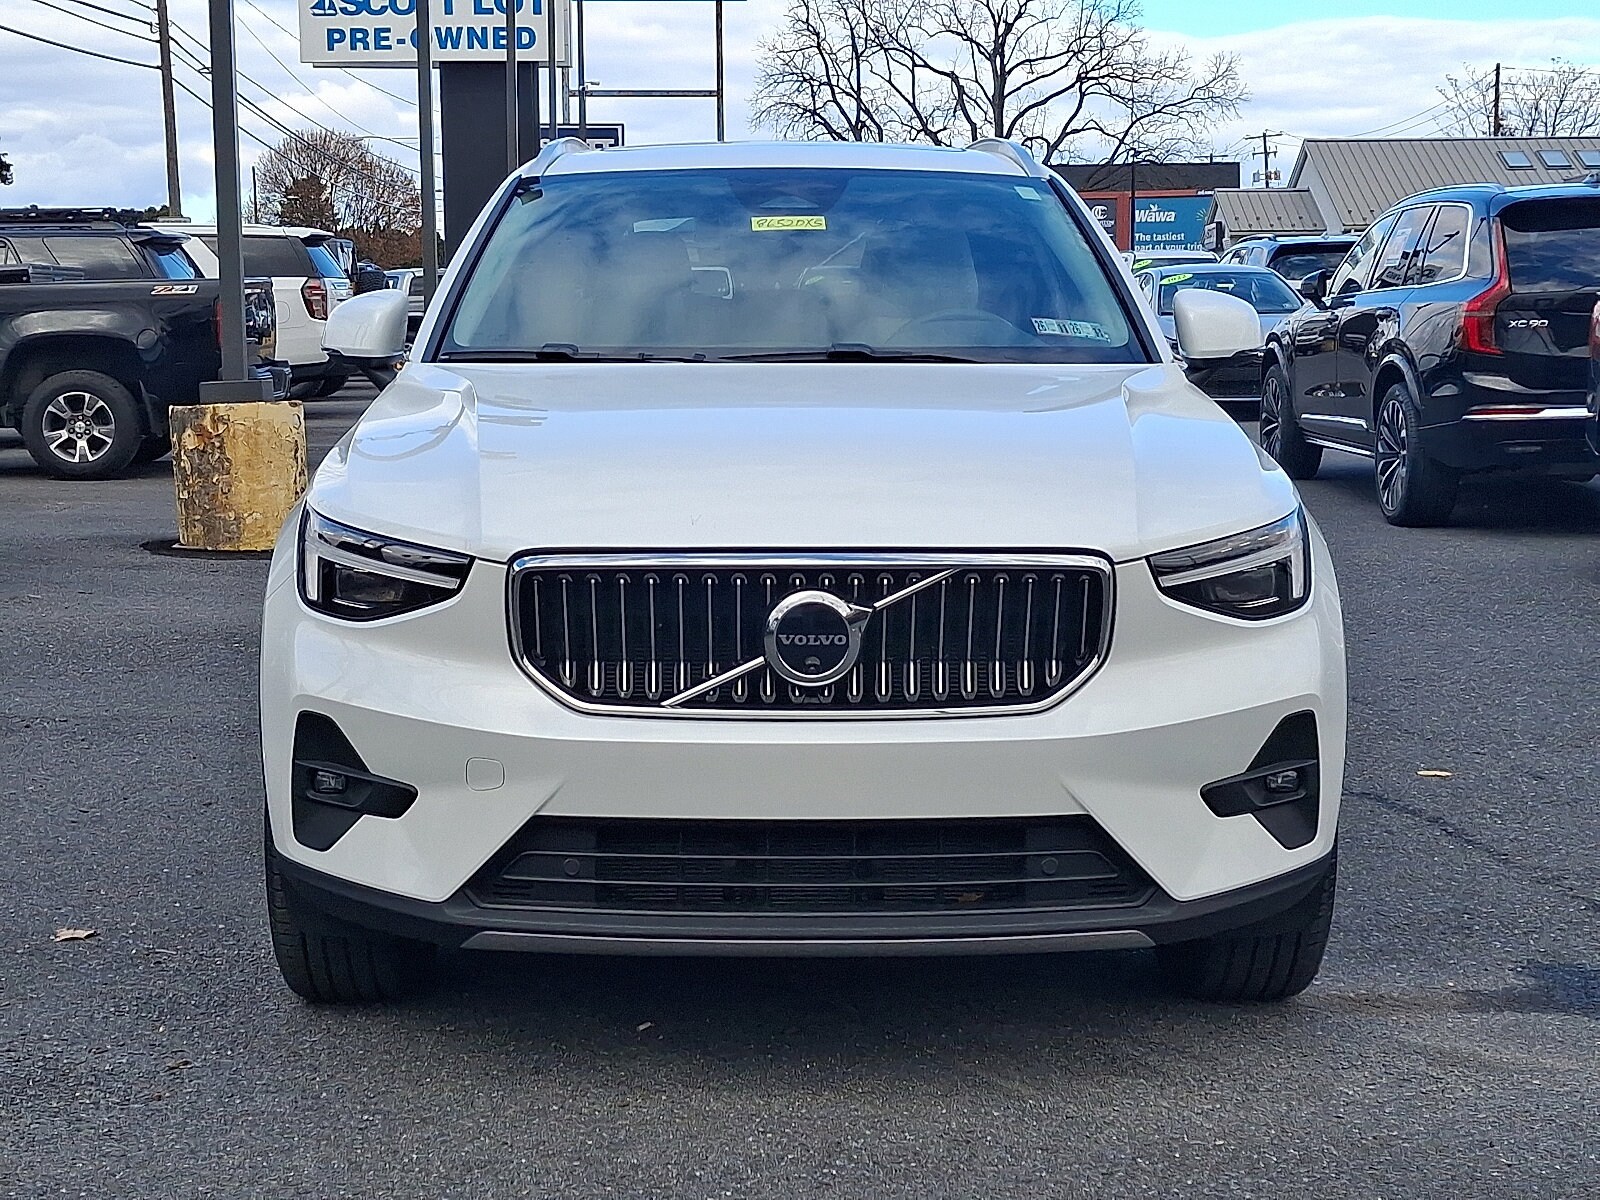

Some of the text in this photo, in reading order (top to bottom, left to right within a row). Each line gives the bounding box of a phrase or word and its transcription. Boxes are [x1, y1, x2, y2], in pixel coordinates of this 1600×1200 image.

[326, 26, 537, 51] PRE-WNED
[1135, 209, 1176, 222] Wawa
[1135, 231, 1185, 242] The tastiest
[151, 284, 199, 295] Z71
[778, 634, 847, 646] VOLVO
